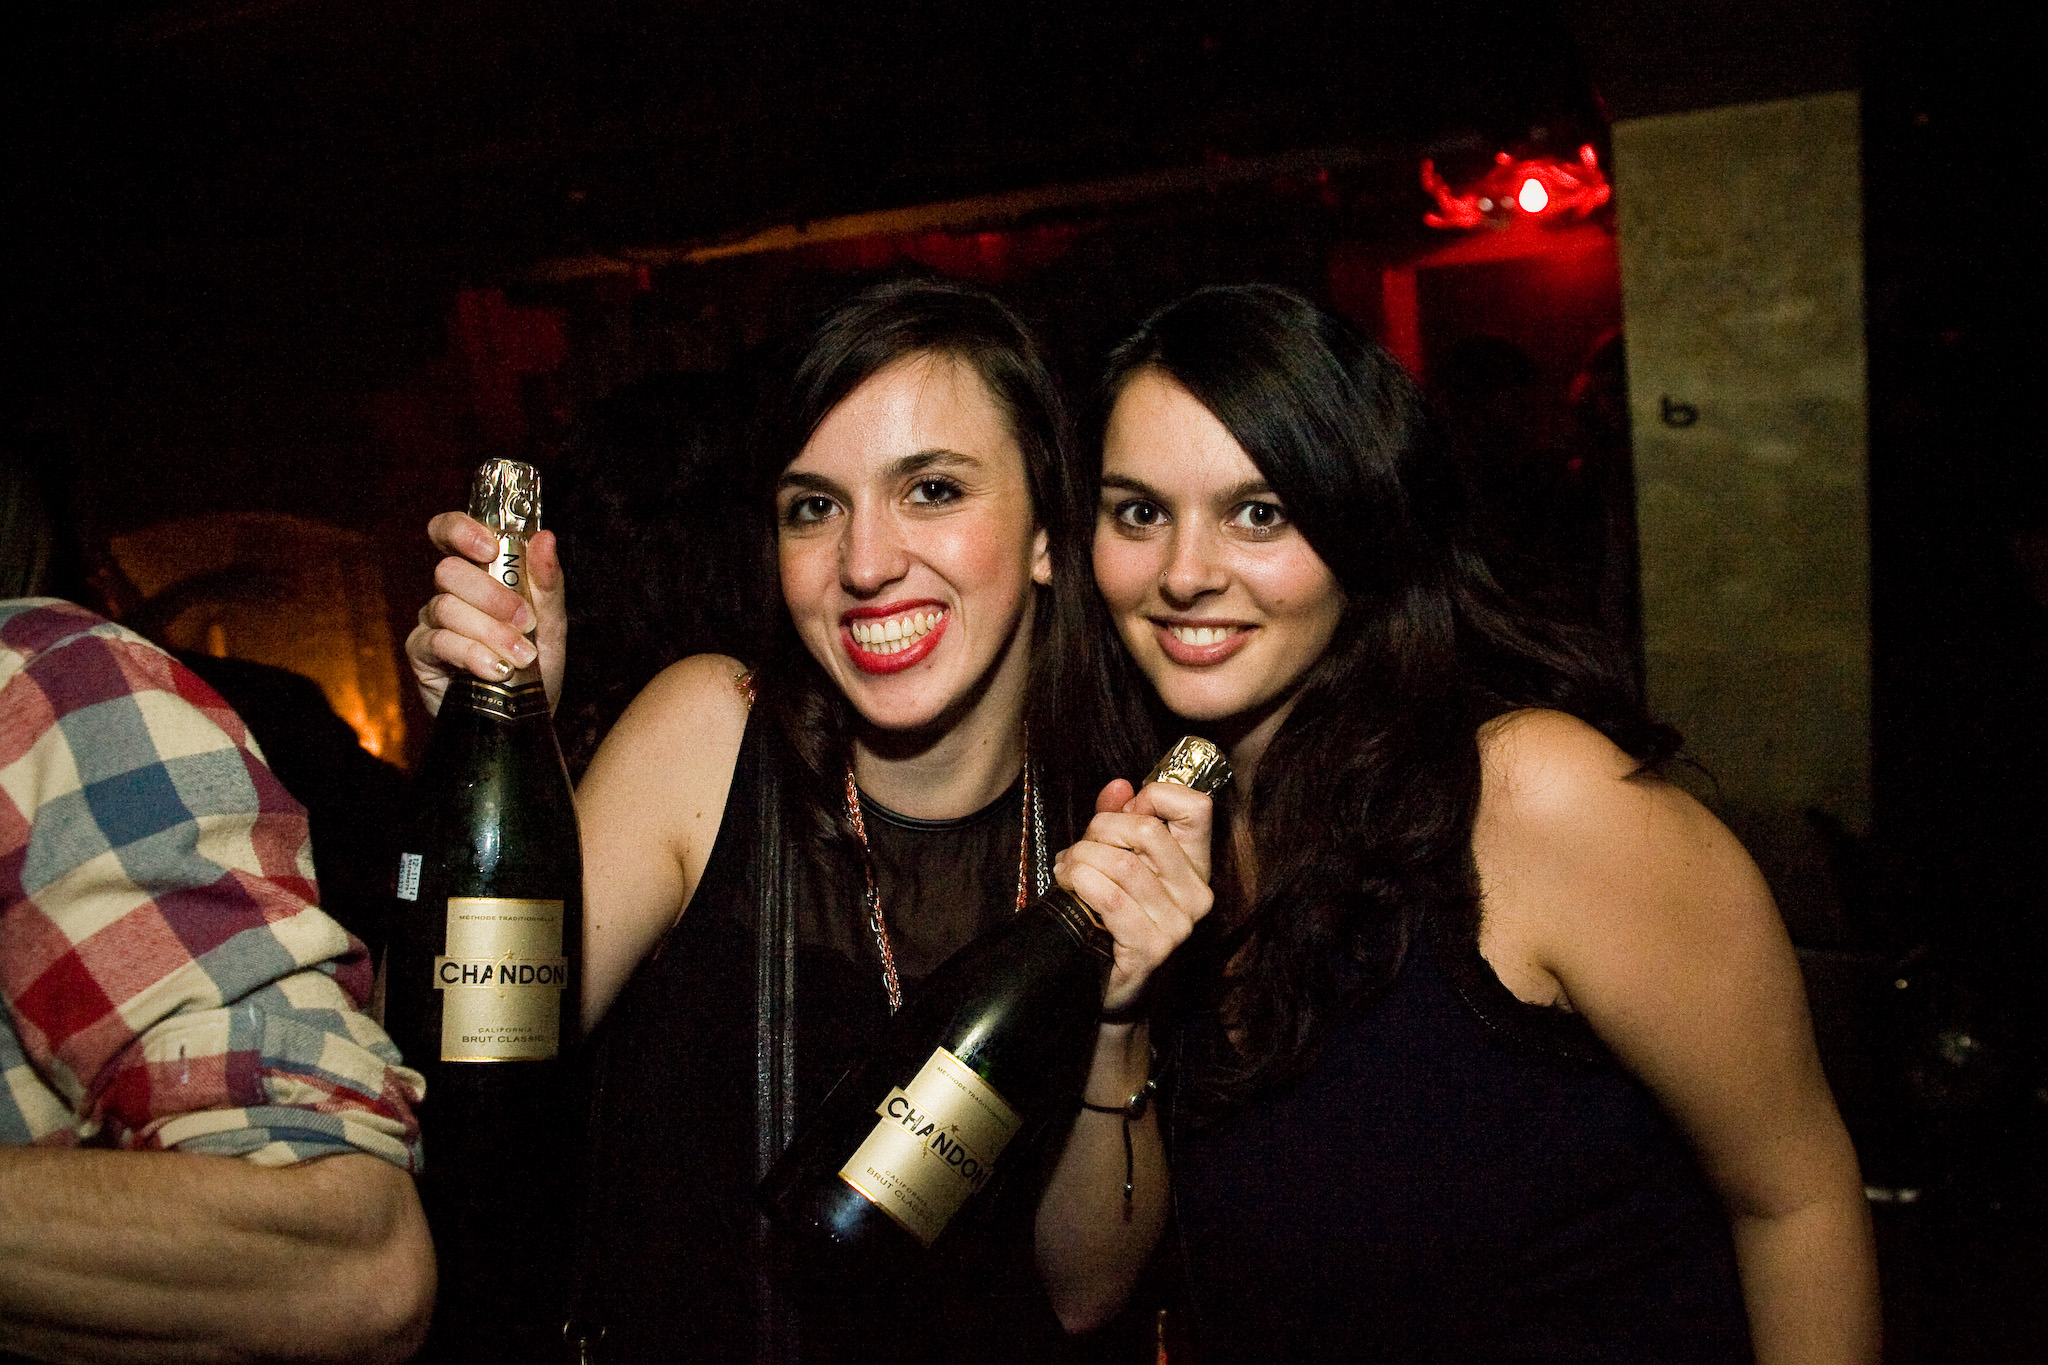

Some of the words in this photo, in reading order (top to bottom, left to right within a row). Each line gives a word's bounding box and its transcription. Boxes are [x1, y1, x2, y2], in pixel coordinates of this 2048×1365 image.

[440, 962, 565, 984] CHANDON
[887, 1097, 989, 1186] CHANDON
[866, 1167, 894, 1189] BRUT
